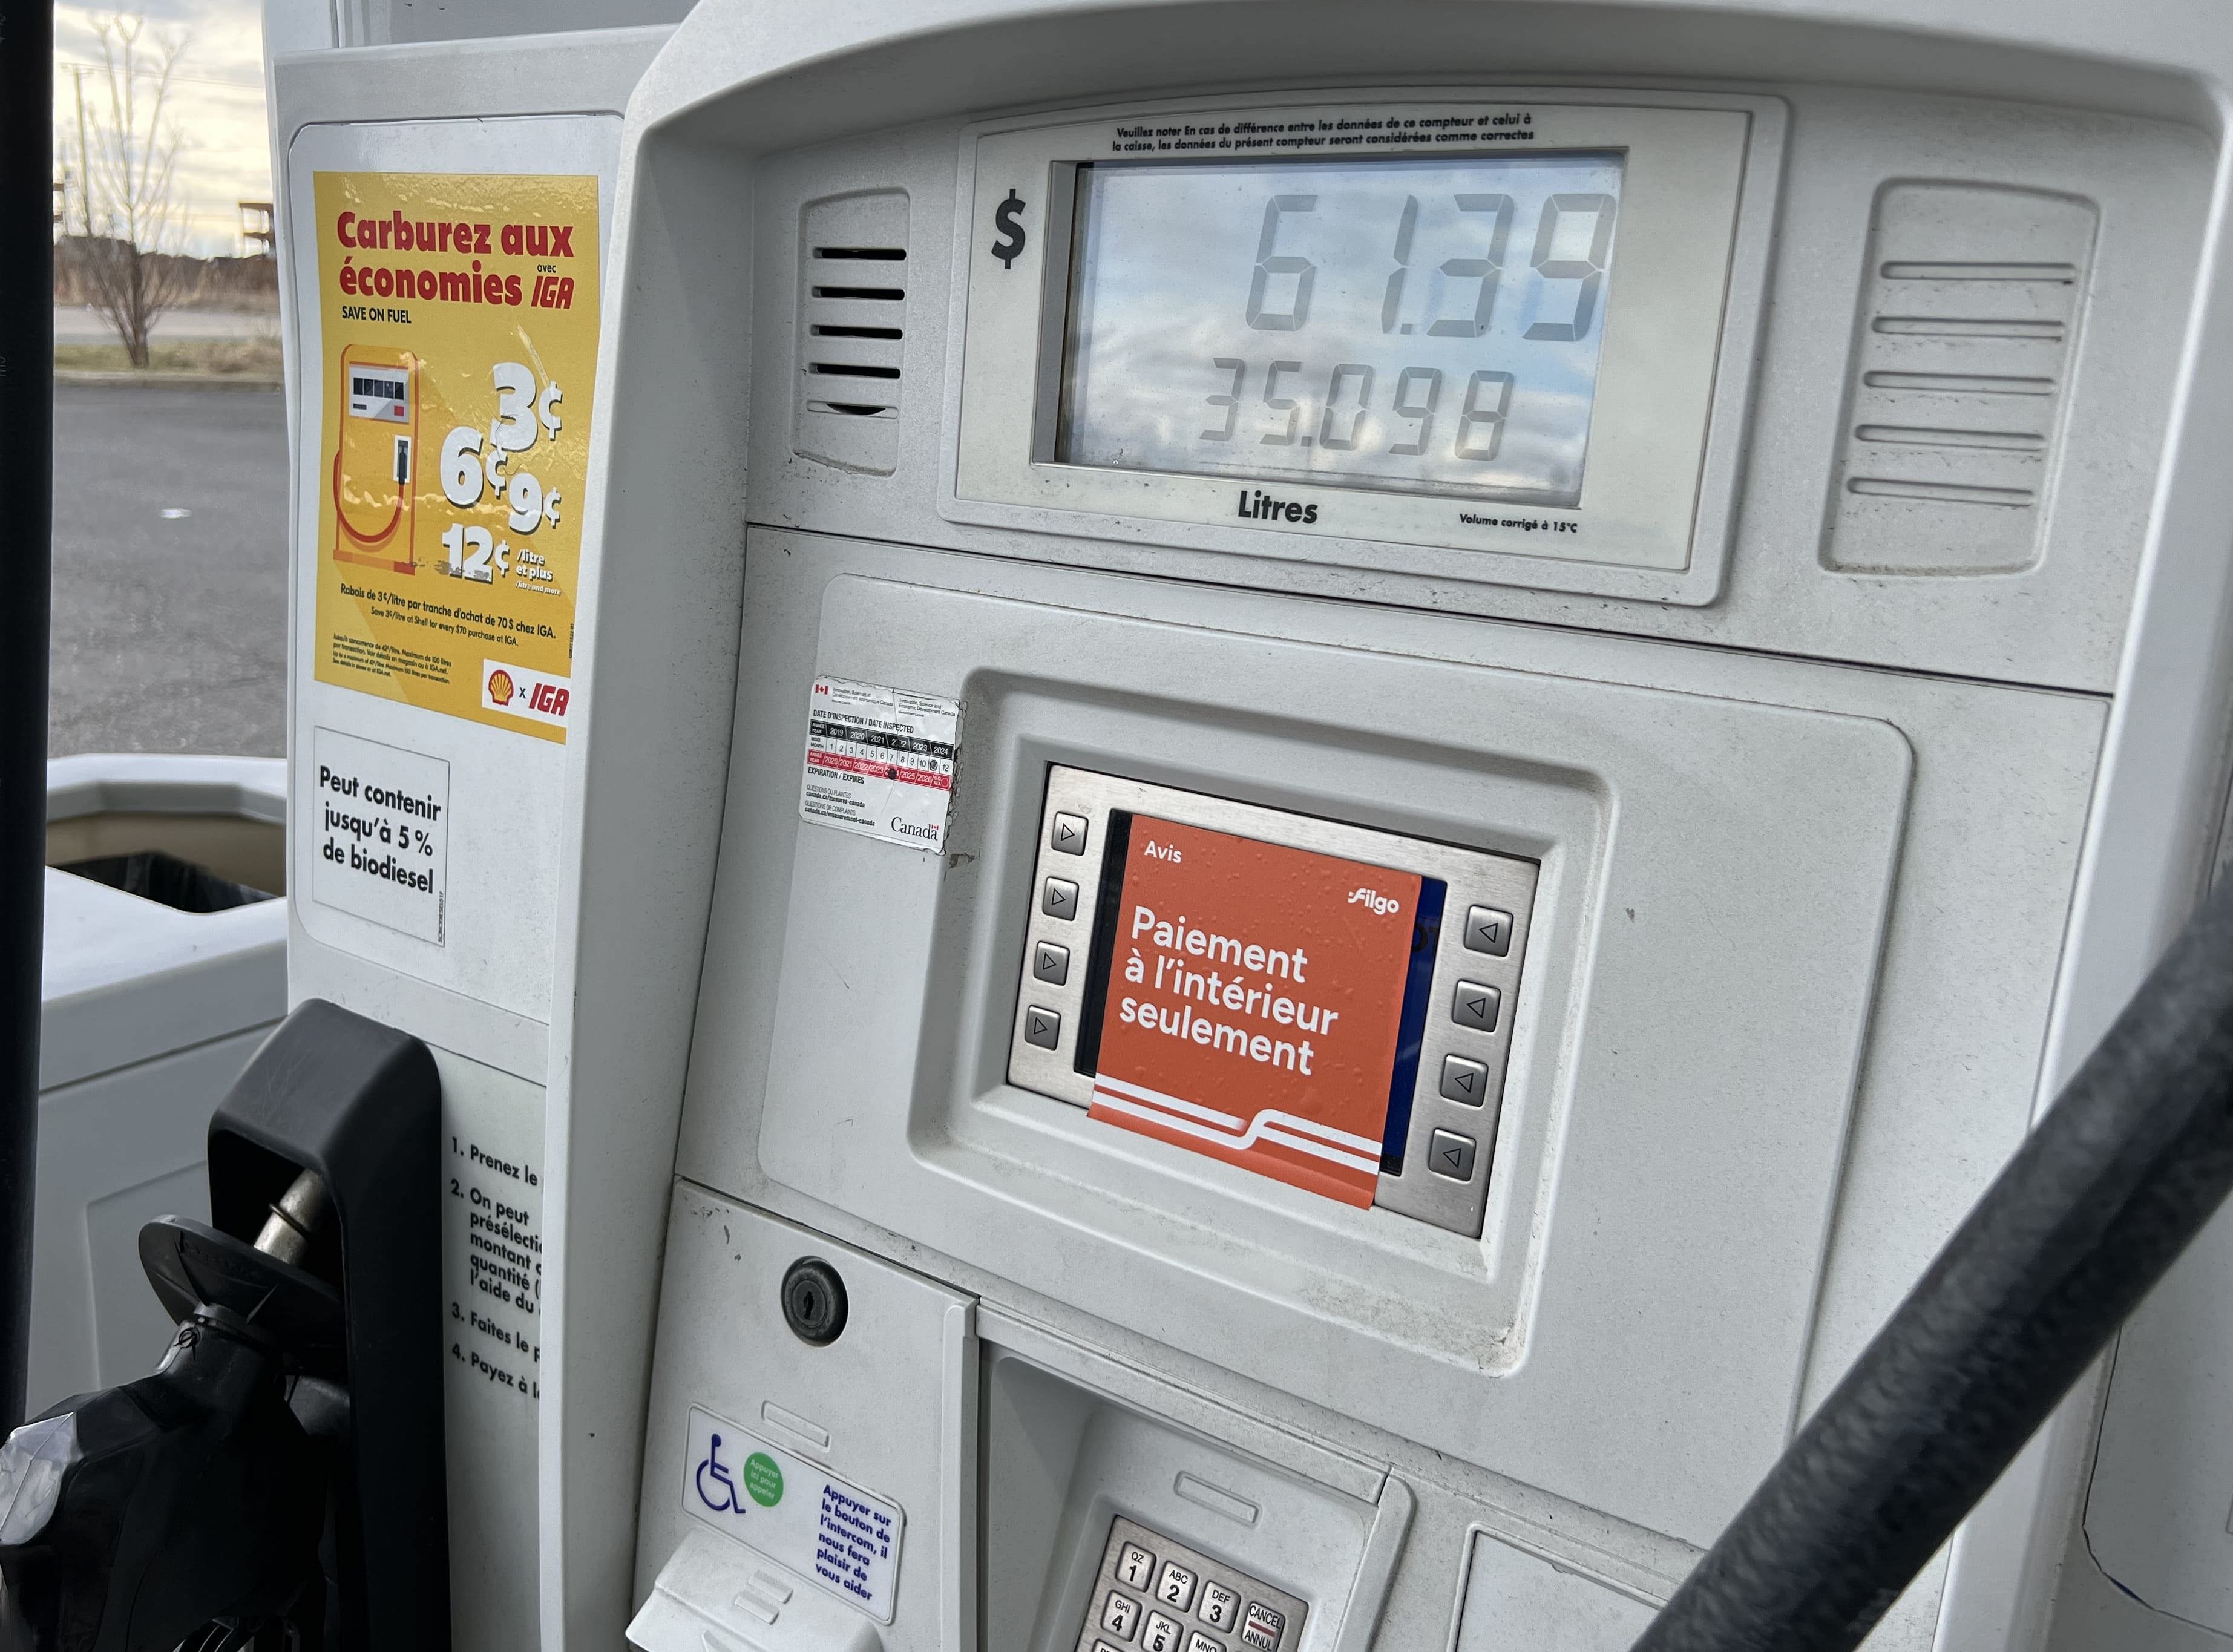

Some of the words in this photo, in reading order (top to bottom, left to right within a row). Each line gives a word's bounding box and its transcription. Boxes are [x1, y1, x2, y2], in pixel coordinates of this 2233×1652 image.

[1112, 141, 1121, 151] la
[1124, 140, 1155, 152] caisse,
[1158, 139, 1172, 150] les
[1175, 139, 1215, 149] données
[1219, 137, 1231, 148] du
[1235, 137, 1273, 150] présent
[1276, 136, 1325, 149] compteur
[1329, 134, 1362, 145] seront
[1366, 131, 1431, 144] considérées
[1435, 133, 1477, 142] comme
[1480, 130, 1534, 141] correctes
[1116, 126, 1153, 138] Veuillez
[1156, 128, 1182, 137] noter
[1184, 126, 1196, 136] En
[1199, 126, 1215, 135] cas
[1218, 123, 1230, 134] de
[1234, 122, 1284, 134] différence
[1288, 123, 1315, 132] entre
[1318, 119, 1333, 131] les
[1337, 119, 1382, 131] données
[1386, 117, 1400, 129] de
[1403, 120, 1416, 128] ce
[1420, 117, 1474, 129] compteur
[1478, 115, 1489, 126] et
[1492, 113, 1520, 125] celui
[1524, 113, 1532, 125] à
[338, 211, 491, 254] Carburez
[501, 224, 574, 257] aux
[991, 188, 1026, 270] $
[340, 256, 522, 306] économies
[531, 276, 574, 309] IGA
[537, 263, 556, 273] avec
[1245, 193, 1616, 343] 61.39
[342, 306, 366, 320] SAVE
[369, 307, 385, 321] ON
[388, 309, 412, 324] FUEL
[490, 362, 562, 451] 3¢
[1198, 357, 1515, 462] 35.098
[509, 473, 562, 535] 9¢
[1238, 489, 1318, 524] Litres
[1459, 513, 1497, 526] Volume
[1501, 517, 1538, 531] corrigé
[1541, 520, 1549, 530] à
[1553, 522, 1577, 533] 15°C
[516, 566, 528, 575] et
[529, 567, 553, 582] plus
[545, 587, 561, 595] more
[341, 583, 364, 598] Rabais
[367, 589, 376, 600] de
[408, 600, 421, 610] par
[423, 601, 451, 617] tranche
[454, 608, 483, 623] d'achat
[485, 614, 495, 626] de
[516, 621, 534, 634] chez
[537, 624, 556, 639] IGA.
[372, 606, 384, 617] Save
[415, 616, 428, 626] Shell
[439, 624, 454, 634] every
[456, 625, 467, 635] $70
[468, 630, 495, 641] purchase
[505, 637, 519, 646] IGA.
[529, 682, 569, 716] IGA
[813, 709, 827, 718] DATE
[828, 712, 864, 724] D'INSPECTION
[869, 719, 882, 728] DATE
[883, 722, 914, 733] INSPECTED
[871, 735, 884, 744] 2021
[913, 742, 927, 752] 2023
[934, 746, 948, 755] 2024
[808, 767, 838, 779] EXPIRATION
[842, 773, 864, 784] EXPIRES
[320, 765, 359, 797] Peut
[364, 785, 441, 821] contenir
[325, 801, 391, 844] jusqu'à
[398, 825, 409, 849] 5
[415, 830, 433, 856] %
[891, 817, 939, 841] Canada
[323, 837, 345, 864] de
[351, 844, 433, 894] biodiesel
[1144, 839, 1182, 864] Avis
[1132, 906, 1307, 983] Paiement
[1124, 949, 1145, 983] à
[1155, 956, 1339, 1035] l'intérieur
[1120, 997, 1314, 1077] seulement
[451, 1136, 464, 1156] 1.
[471, 1144, 520, 1180] Prenez
[526, 1165, 537, 1186] le
[451, 1179, 464, 1199] 2.
[470, 1187, 491, 1209] On
[497, 1201, 529, 1226] peut
[471, 1233, 537, 1270] montant
[471, 1254, 530, 1290] quantité
[471, 1268, 510, 1302] l'aide
[516, 1294, 534, 1314] du
[451, 1302, 464, 1322] 3.
[471, 1312, 511, 1345] Faites
[517, 1332, 528, 1353] le
[451, 1343, 465, 1362] 4.
[471, 1352, 513, 1388] Payez
[519, 1375, 527, 1394] à
[750, 1458, 778, 1480] Appuyer
[750, 1471, 759, 1481] ici
[760, 1477, 776, 1490] pour
[750, 1482, 775, 1500] appeler
[823, 1484, 870, 1515] Appuyer
[873, 1510, 891, 1527] sur
[821, 1514, 877, 1554] l'intercom,
[881, 1546, 887, 1559] il
[822, 1498, 831, 1513] le
[835, 1505, 873, 1534] bouton
[876, 1527, 890, 1543] de
[817, 1547, 851, 1572] plaisir
[853, 1566, 867, 1582] de
[819, 1533, 844, 1552] nous
[848, 1547, 870, 1567] fera
[1131, 1552, 1144, 1564] QZ
[816, 1564, 840, 1584] vous
[843, 1578, 873, 1601] aider
[1129, 1565, 1136, 1582] 1
[1169, 1569, 1188, 1584] ABC
[1115, 1600, 1131, 1613] GHI
[1167, 1584, 1180, 1602] 2
[1212, 1589, 1231, 1604] DEF
[1112, 1614, 1123, 1632] 4
[1156, 1621, 1171, 1634] JKL
[1209, 1605, 1222, 1622] 3
[1249, 1605, 1281, 1629] CANCEL
[1152, 1634, 1166, 1652] 5
